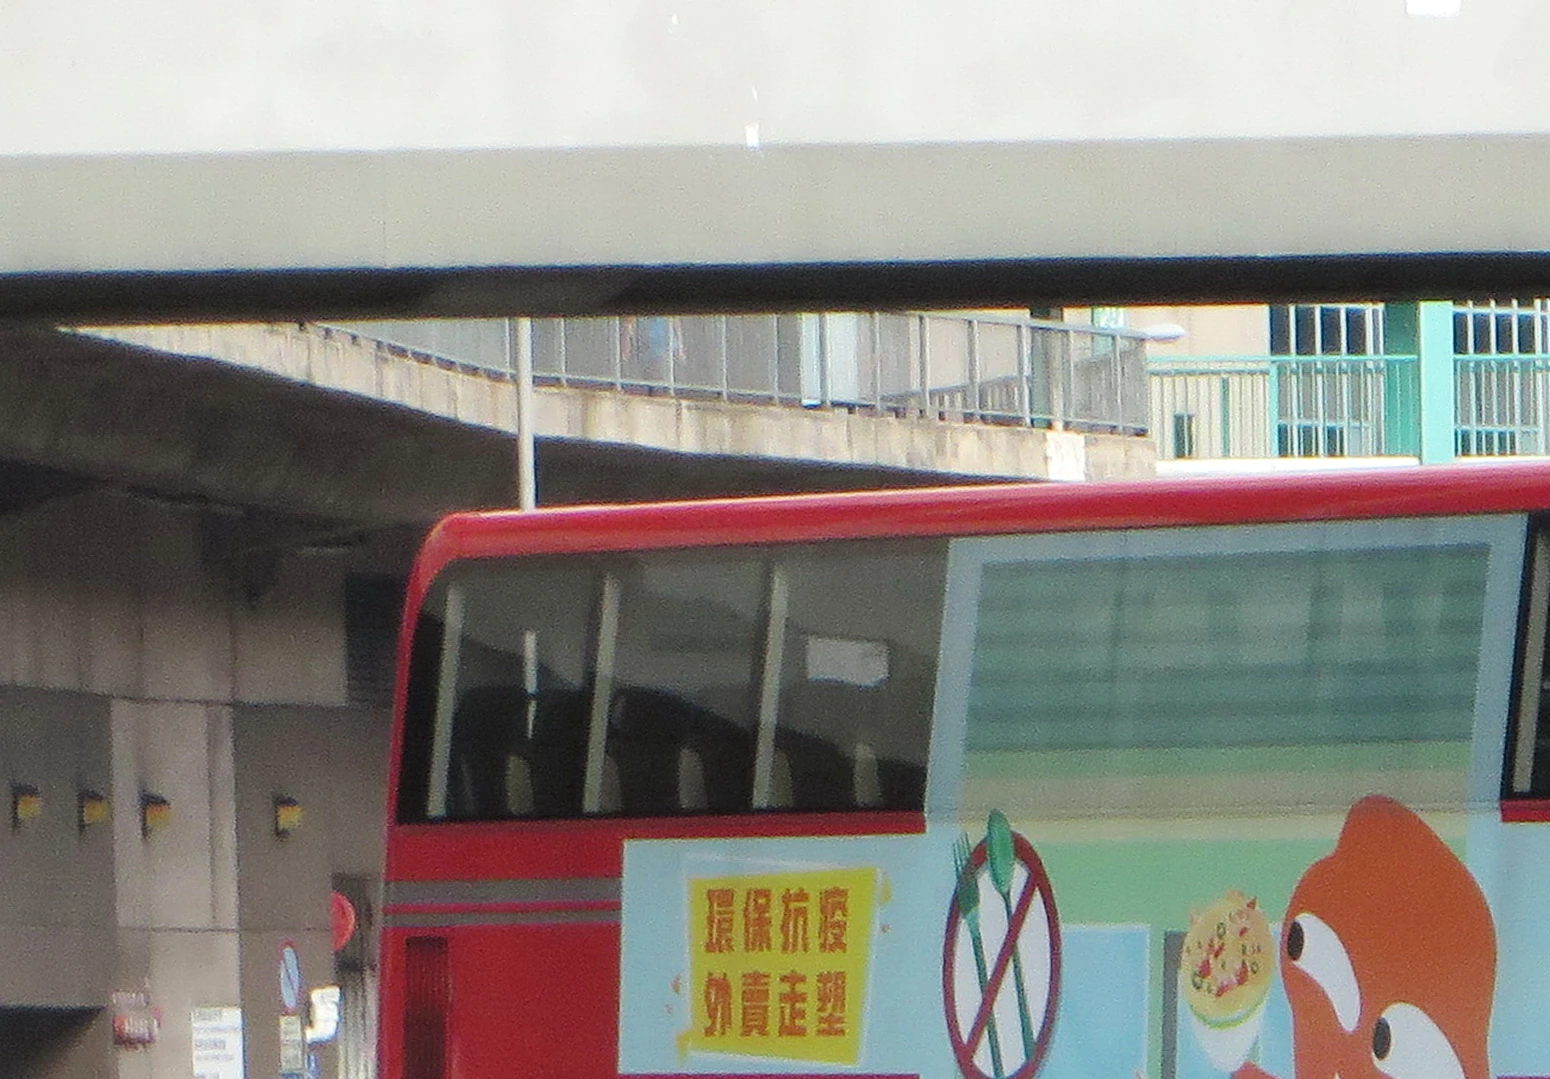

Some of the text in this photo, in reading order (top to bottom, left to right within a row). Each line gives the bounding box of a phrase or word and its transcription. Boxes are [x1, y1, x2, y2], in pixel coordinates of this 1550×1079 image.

[705, 887, 848, 953] 環保抗疫
[703, 970, 847, 1038] 外賣走塑
